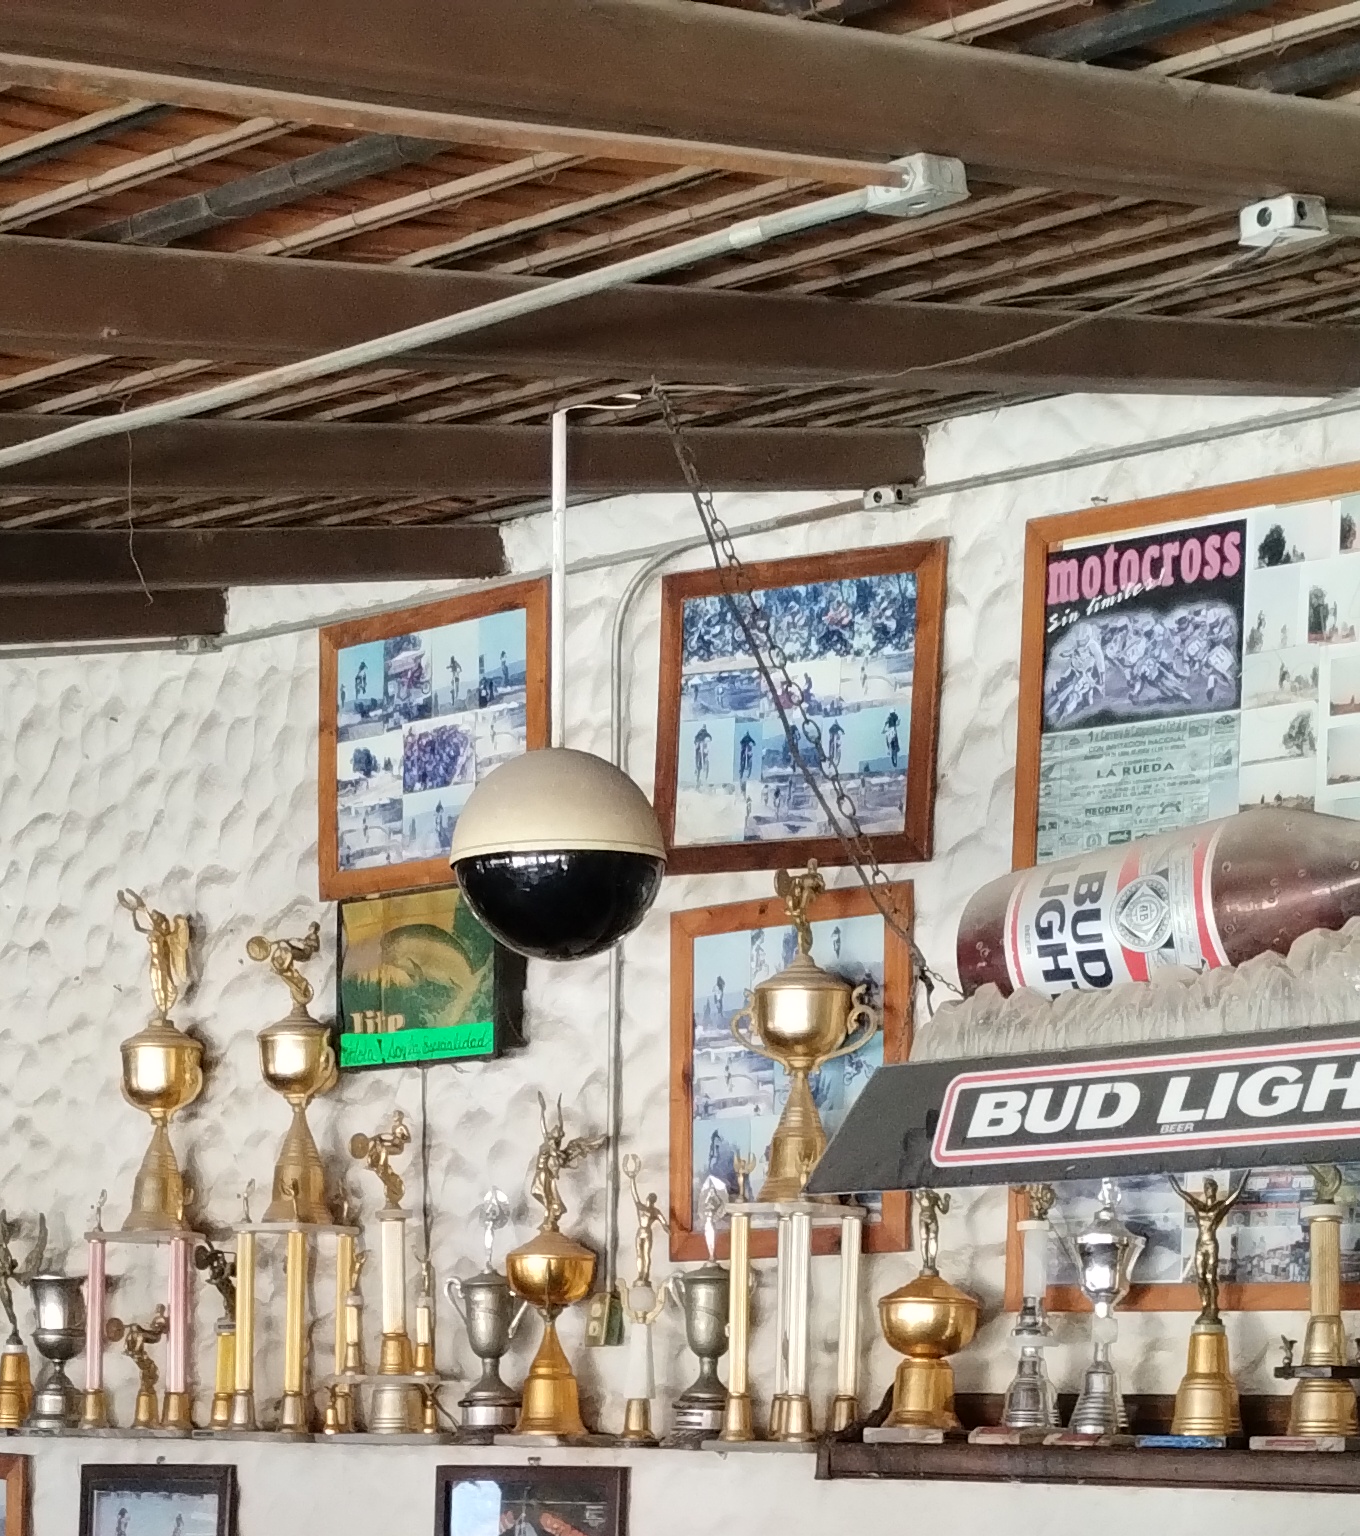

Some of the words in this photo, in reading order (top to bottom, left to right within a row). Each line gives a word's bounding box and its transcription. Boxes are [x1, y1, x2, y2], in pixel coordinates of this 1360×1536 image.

[1047, 531, 1241, 605] motocross
[1047, 608, 1080, 633] Sin
[1097, 768, 1117, 779] LA
[1123, 763, 1175, 776] RUEDA
[1035, 863, 1080, 998] LIGH
[1071, 870, 1114, 988] BUD
[966, 1082, 1141, 1138] BUD
[1160, 1122, 1194, 1134] BEER
